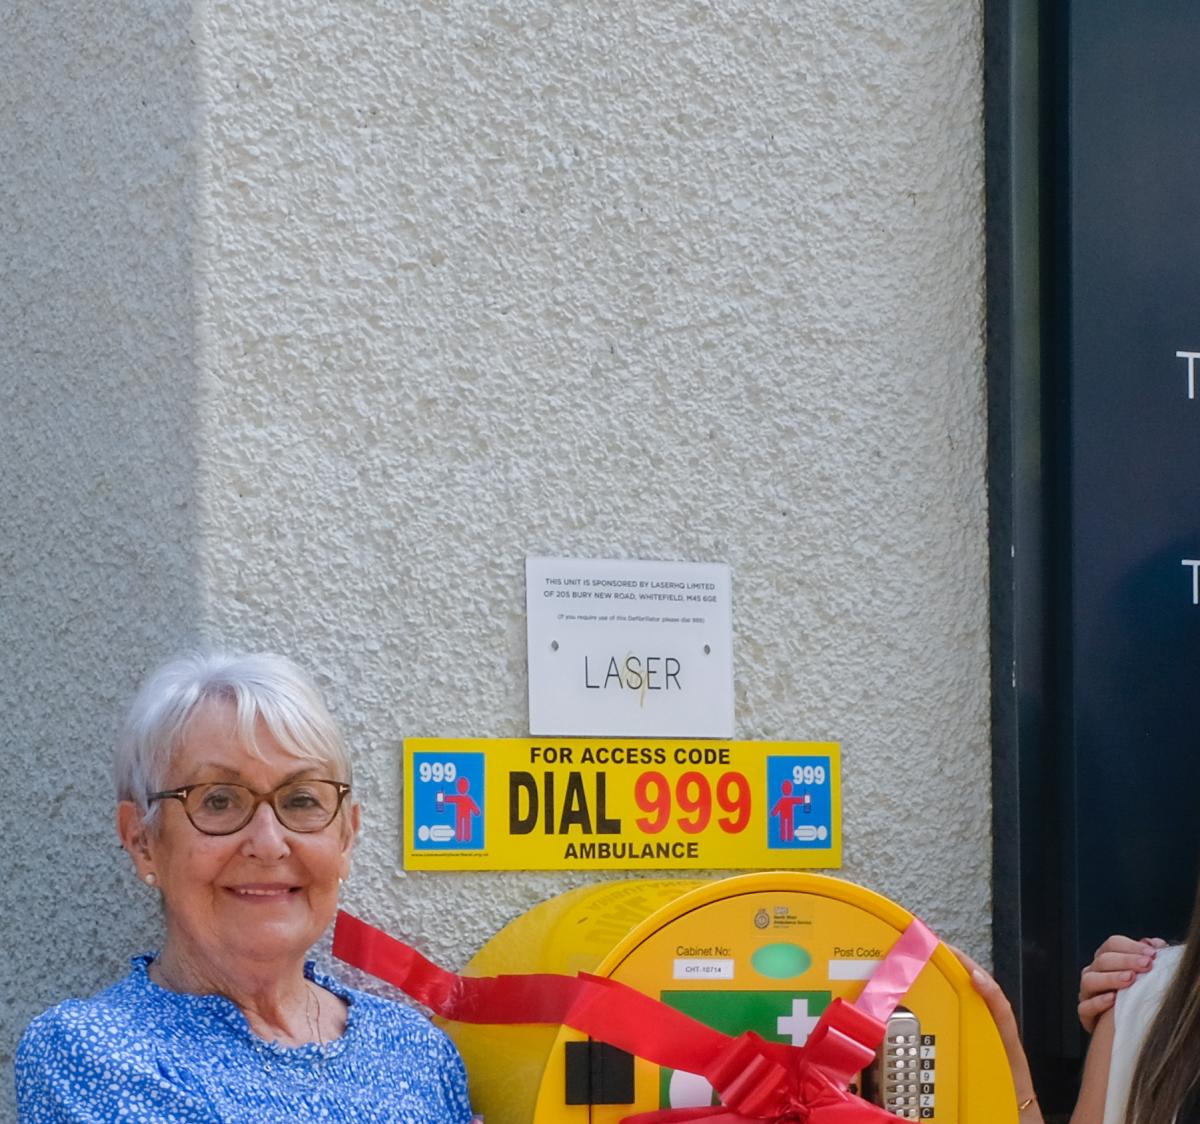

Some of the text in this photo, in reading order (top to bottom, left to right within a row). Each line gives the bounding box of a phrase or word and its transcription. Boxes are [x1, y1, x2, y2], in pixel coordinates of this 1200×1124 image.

[585, 656, 681, 690] LASER
[530, 747, 730, 765] FOR ACCESS CODE
[419, 762, 457, 783] 999
[792, 765, 825, 785] 999
[508, 771, 752, 835] DIAL 999
[563, 842, 699, 859] AMBULANCE
[676, 945, 731, 956] Cabinet No:
[833, 947, 855, 957] Post
